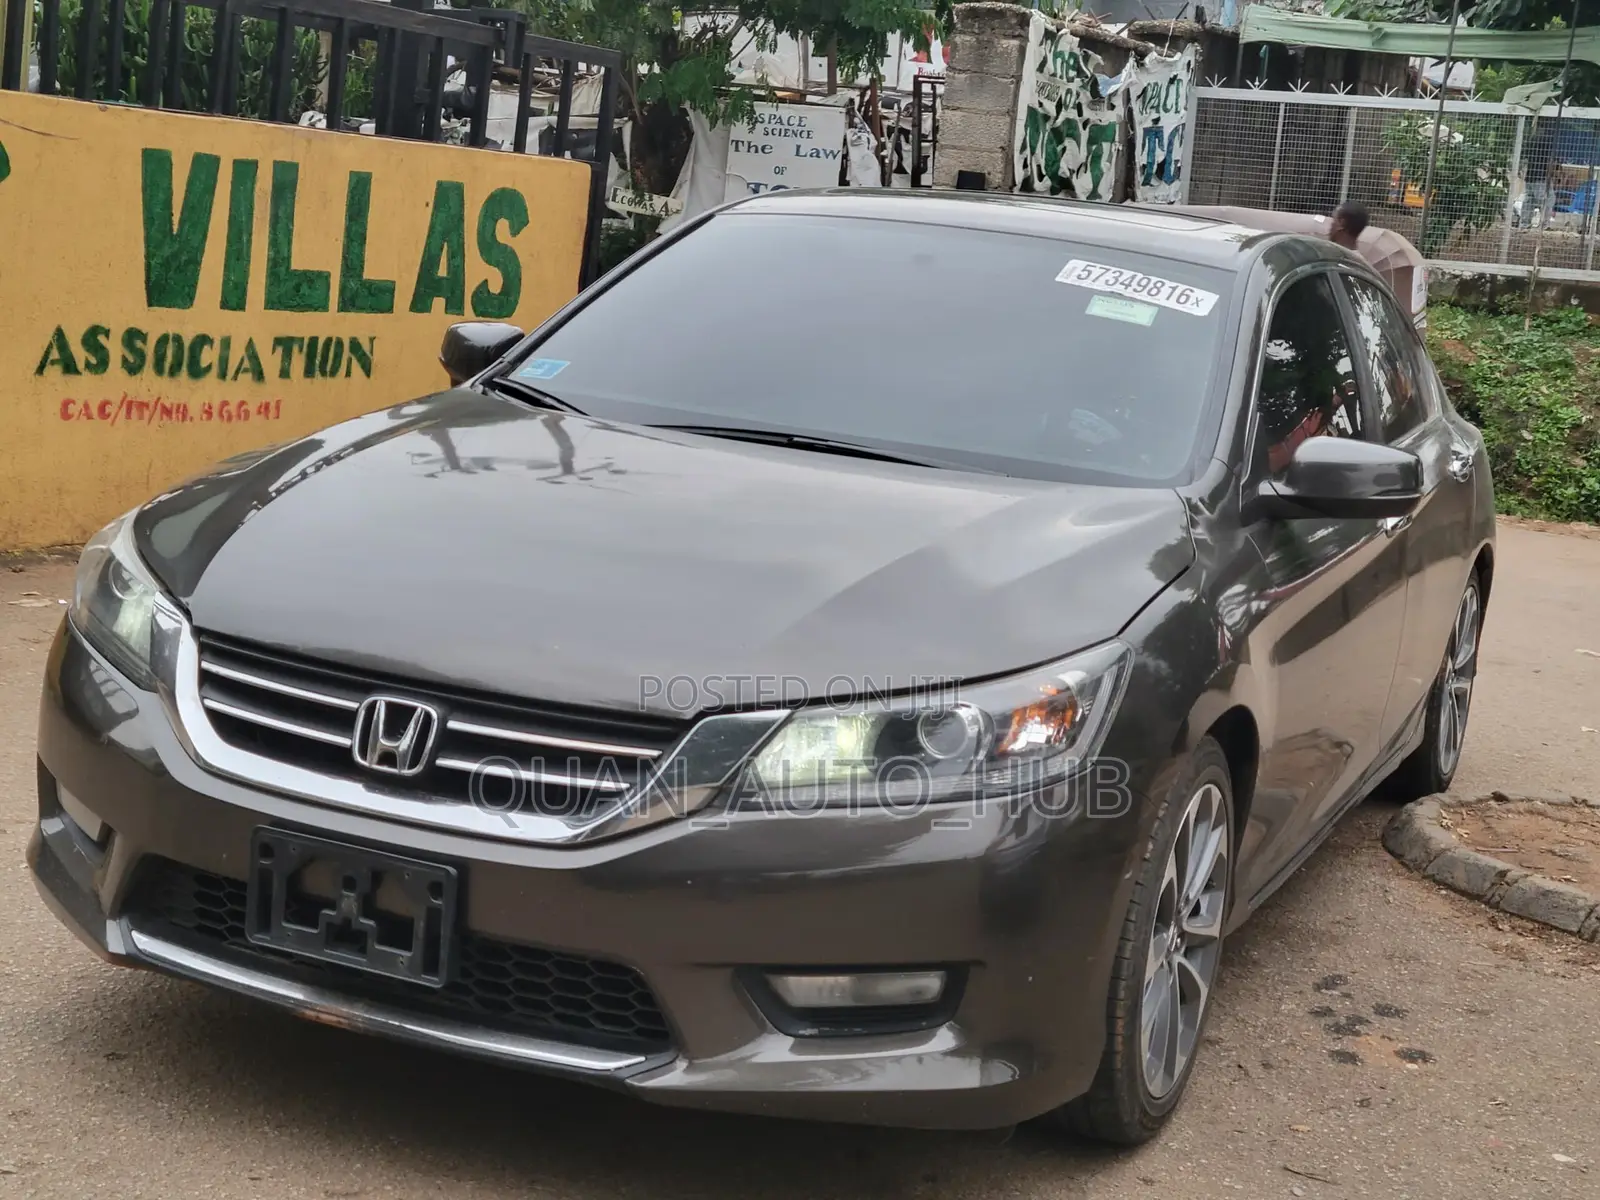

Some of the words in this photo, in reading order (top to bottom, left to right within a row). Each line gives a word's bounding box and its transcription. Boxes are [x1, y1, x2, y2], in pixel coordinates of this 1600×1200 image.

[757, 112, 808, 128] SPACE
[763, 127, 814, 139] SCIENCE
[730, 139, 773, 154] The
[795, 144, 841, 160] Law
[773, 165, 787, 176] OF
[141, 147, 530, 318] VILLAS
[34, 323, 377, 384] ASSOCIATION
